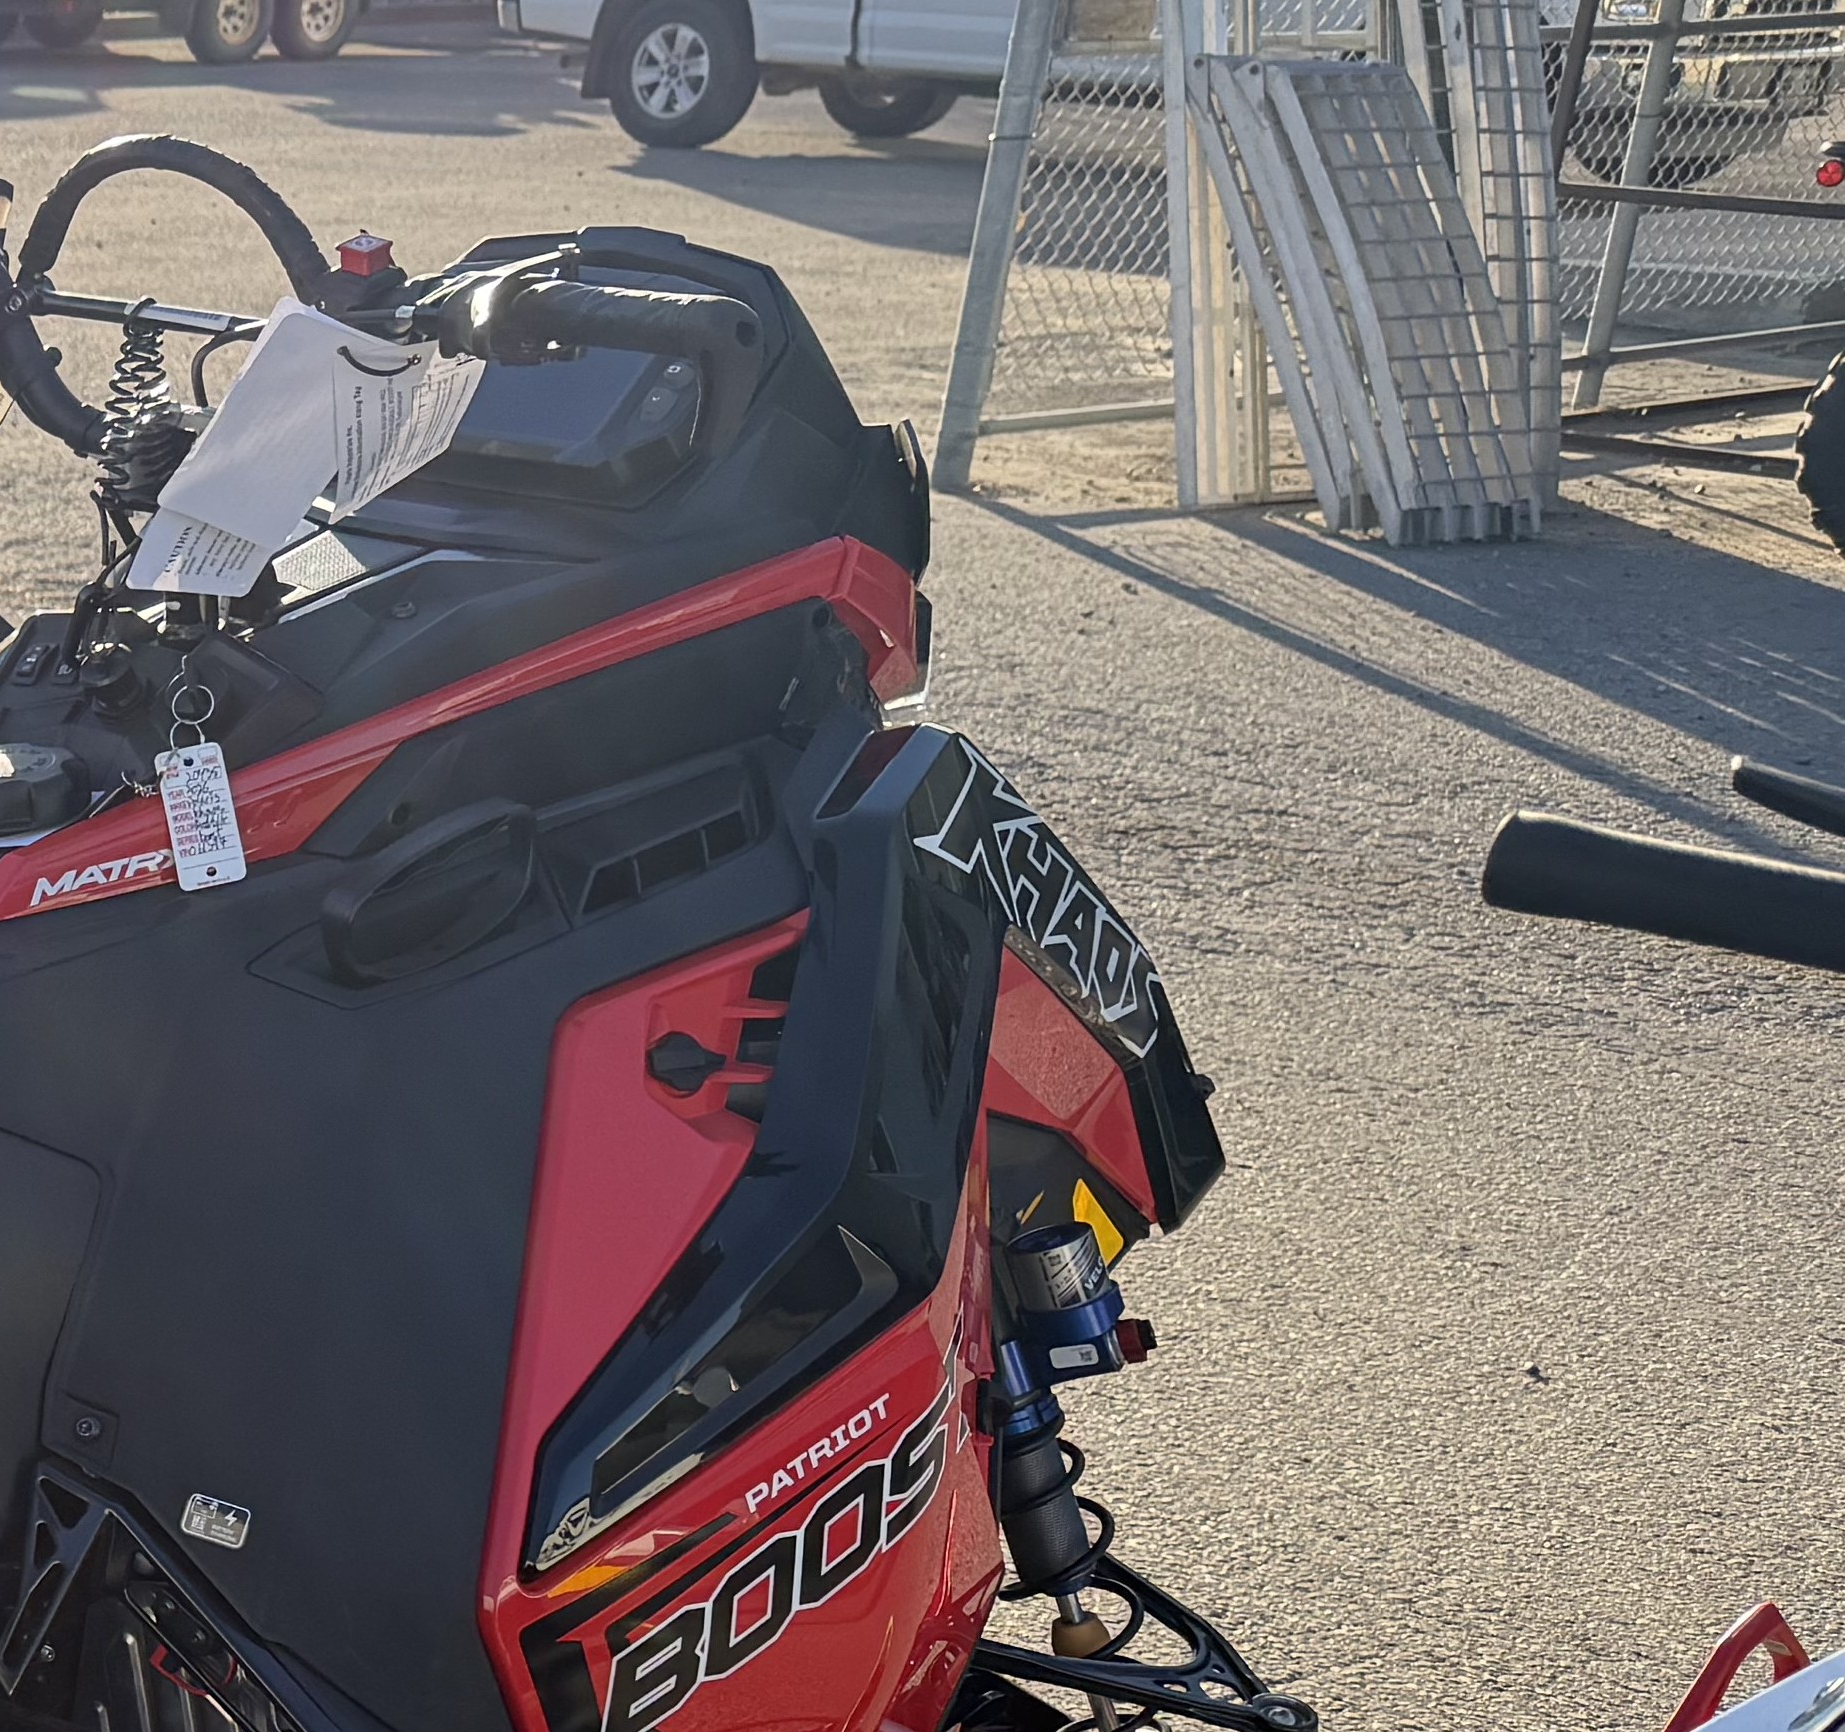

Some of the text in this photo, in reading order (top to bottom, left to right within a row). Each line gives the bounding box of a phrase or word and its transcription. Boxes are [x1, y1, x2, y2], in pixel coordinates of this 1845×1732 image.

[163, 523, 192, 574] CAUTION
[914, 748, 1163, 1057] KHAOS
[743, 1394, 893, 1515] PATRIOT
